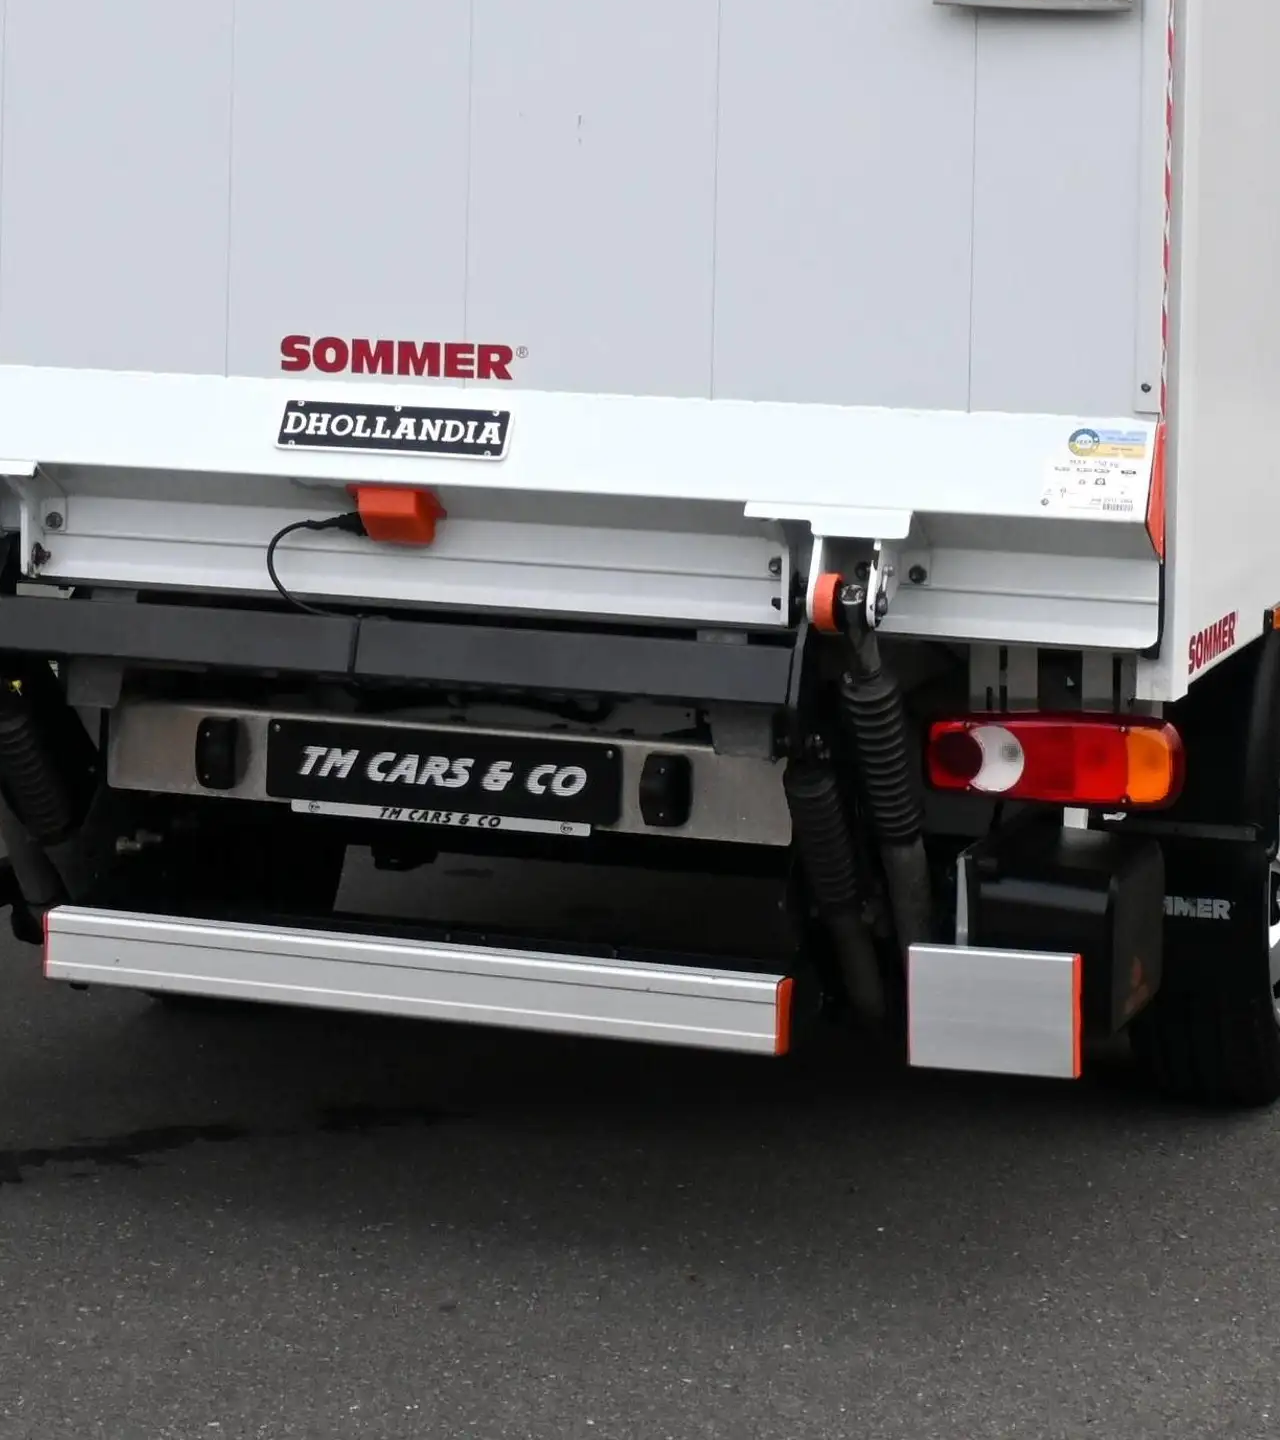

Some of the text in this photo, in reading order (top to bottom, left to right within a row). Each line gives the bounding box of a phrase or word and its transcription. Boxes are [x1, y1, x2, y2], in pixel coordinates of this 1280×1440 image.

[282, 410, 502, 446] DHOLLANDIA
[1188, 611, 1237, 675] SOMMER
[297, 745, 588, 797] TM CARS & CO
[380, 806, 501, 828] TM CARS & CO
